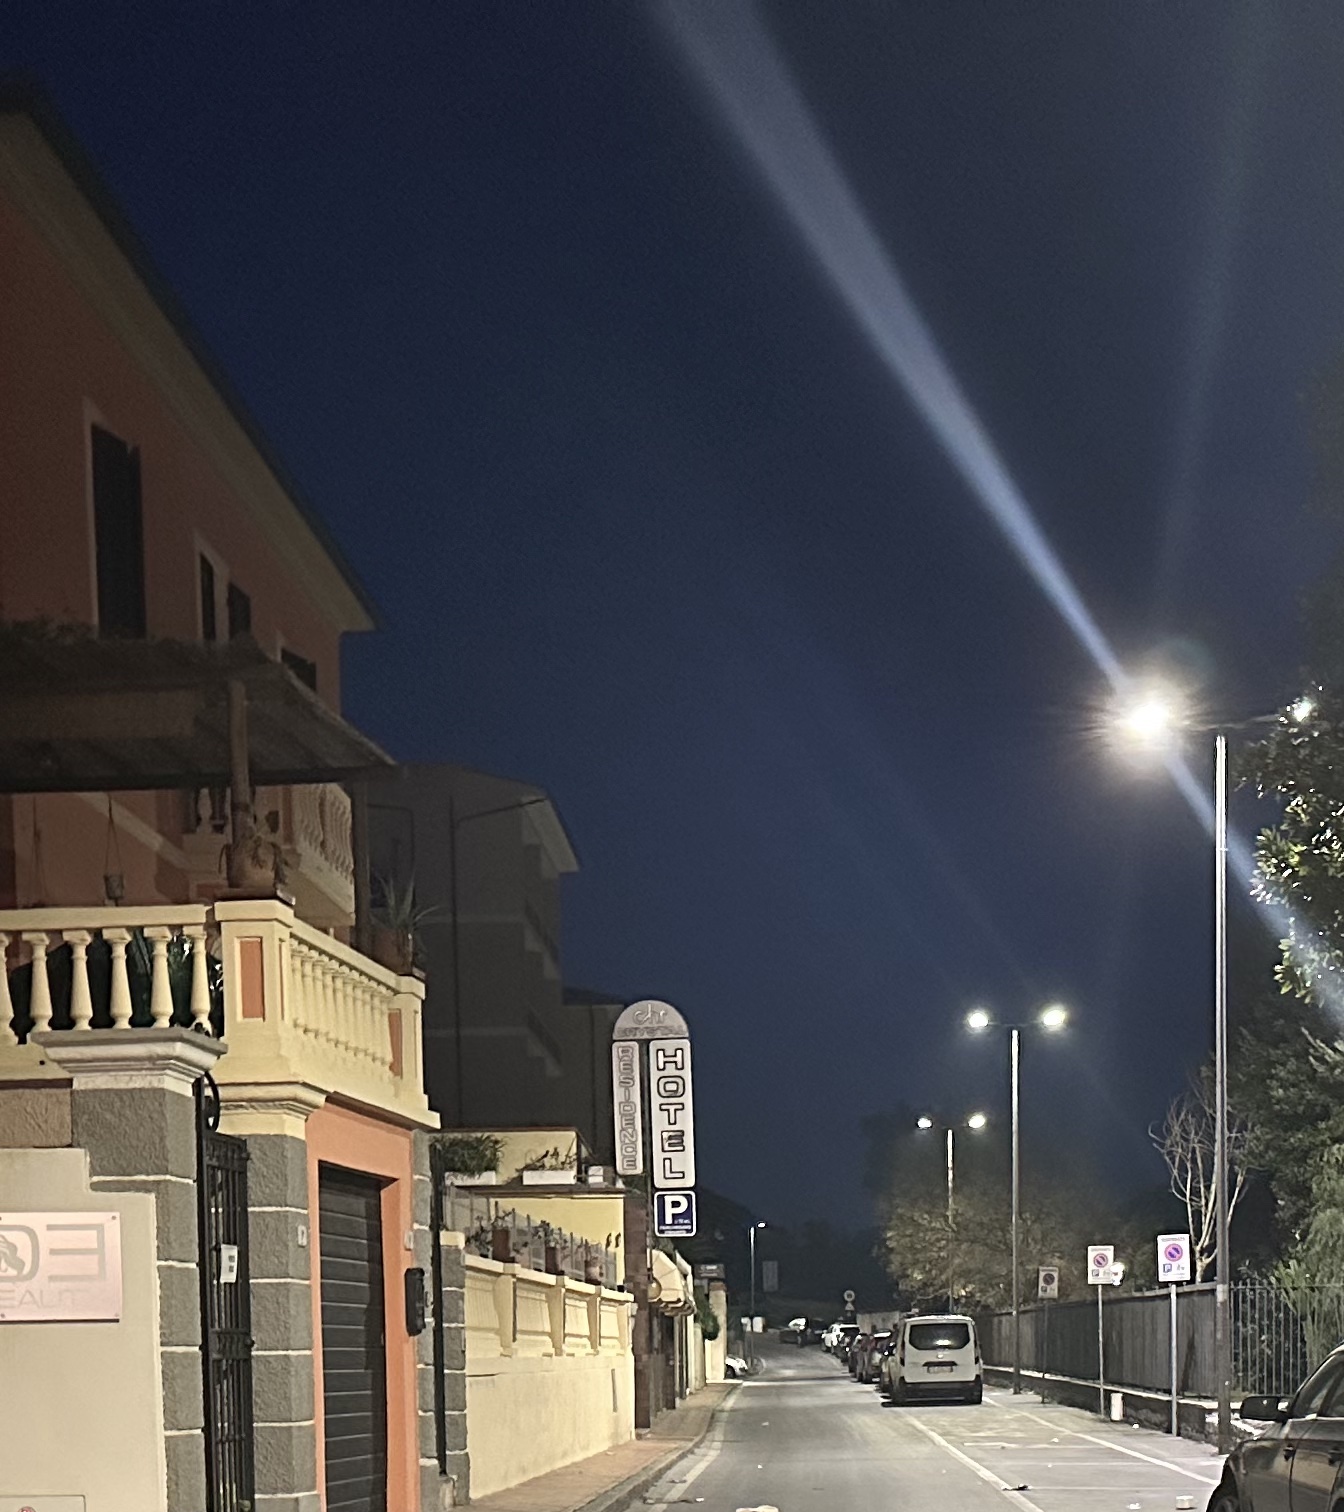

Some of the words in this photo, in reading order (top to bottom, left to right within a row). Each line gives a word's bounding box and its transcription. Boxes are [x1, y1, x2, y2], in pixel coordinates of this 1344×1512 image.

[617, 1045, 638, 1171] RESIDENCE
[656, 1048, 686, 1180] HOTEL
[664, 1195, 689, 1225] P
